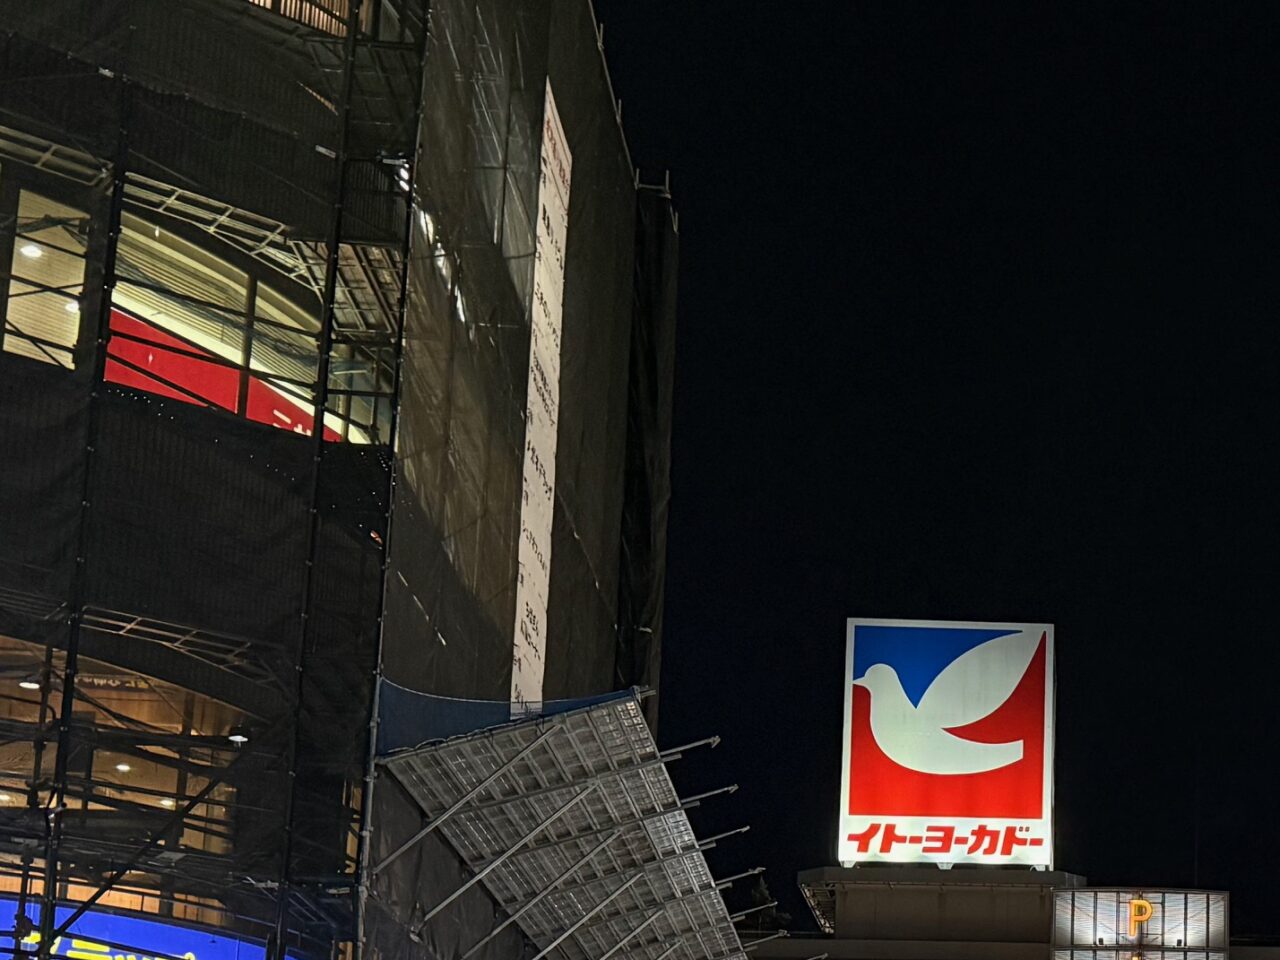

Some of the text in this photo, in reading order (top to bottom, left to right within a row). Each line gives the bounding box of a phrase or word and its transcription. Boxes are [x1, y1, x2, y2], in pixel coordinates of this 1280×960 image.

[847, 823, 1044, 855] イトーヨーカドー
